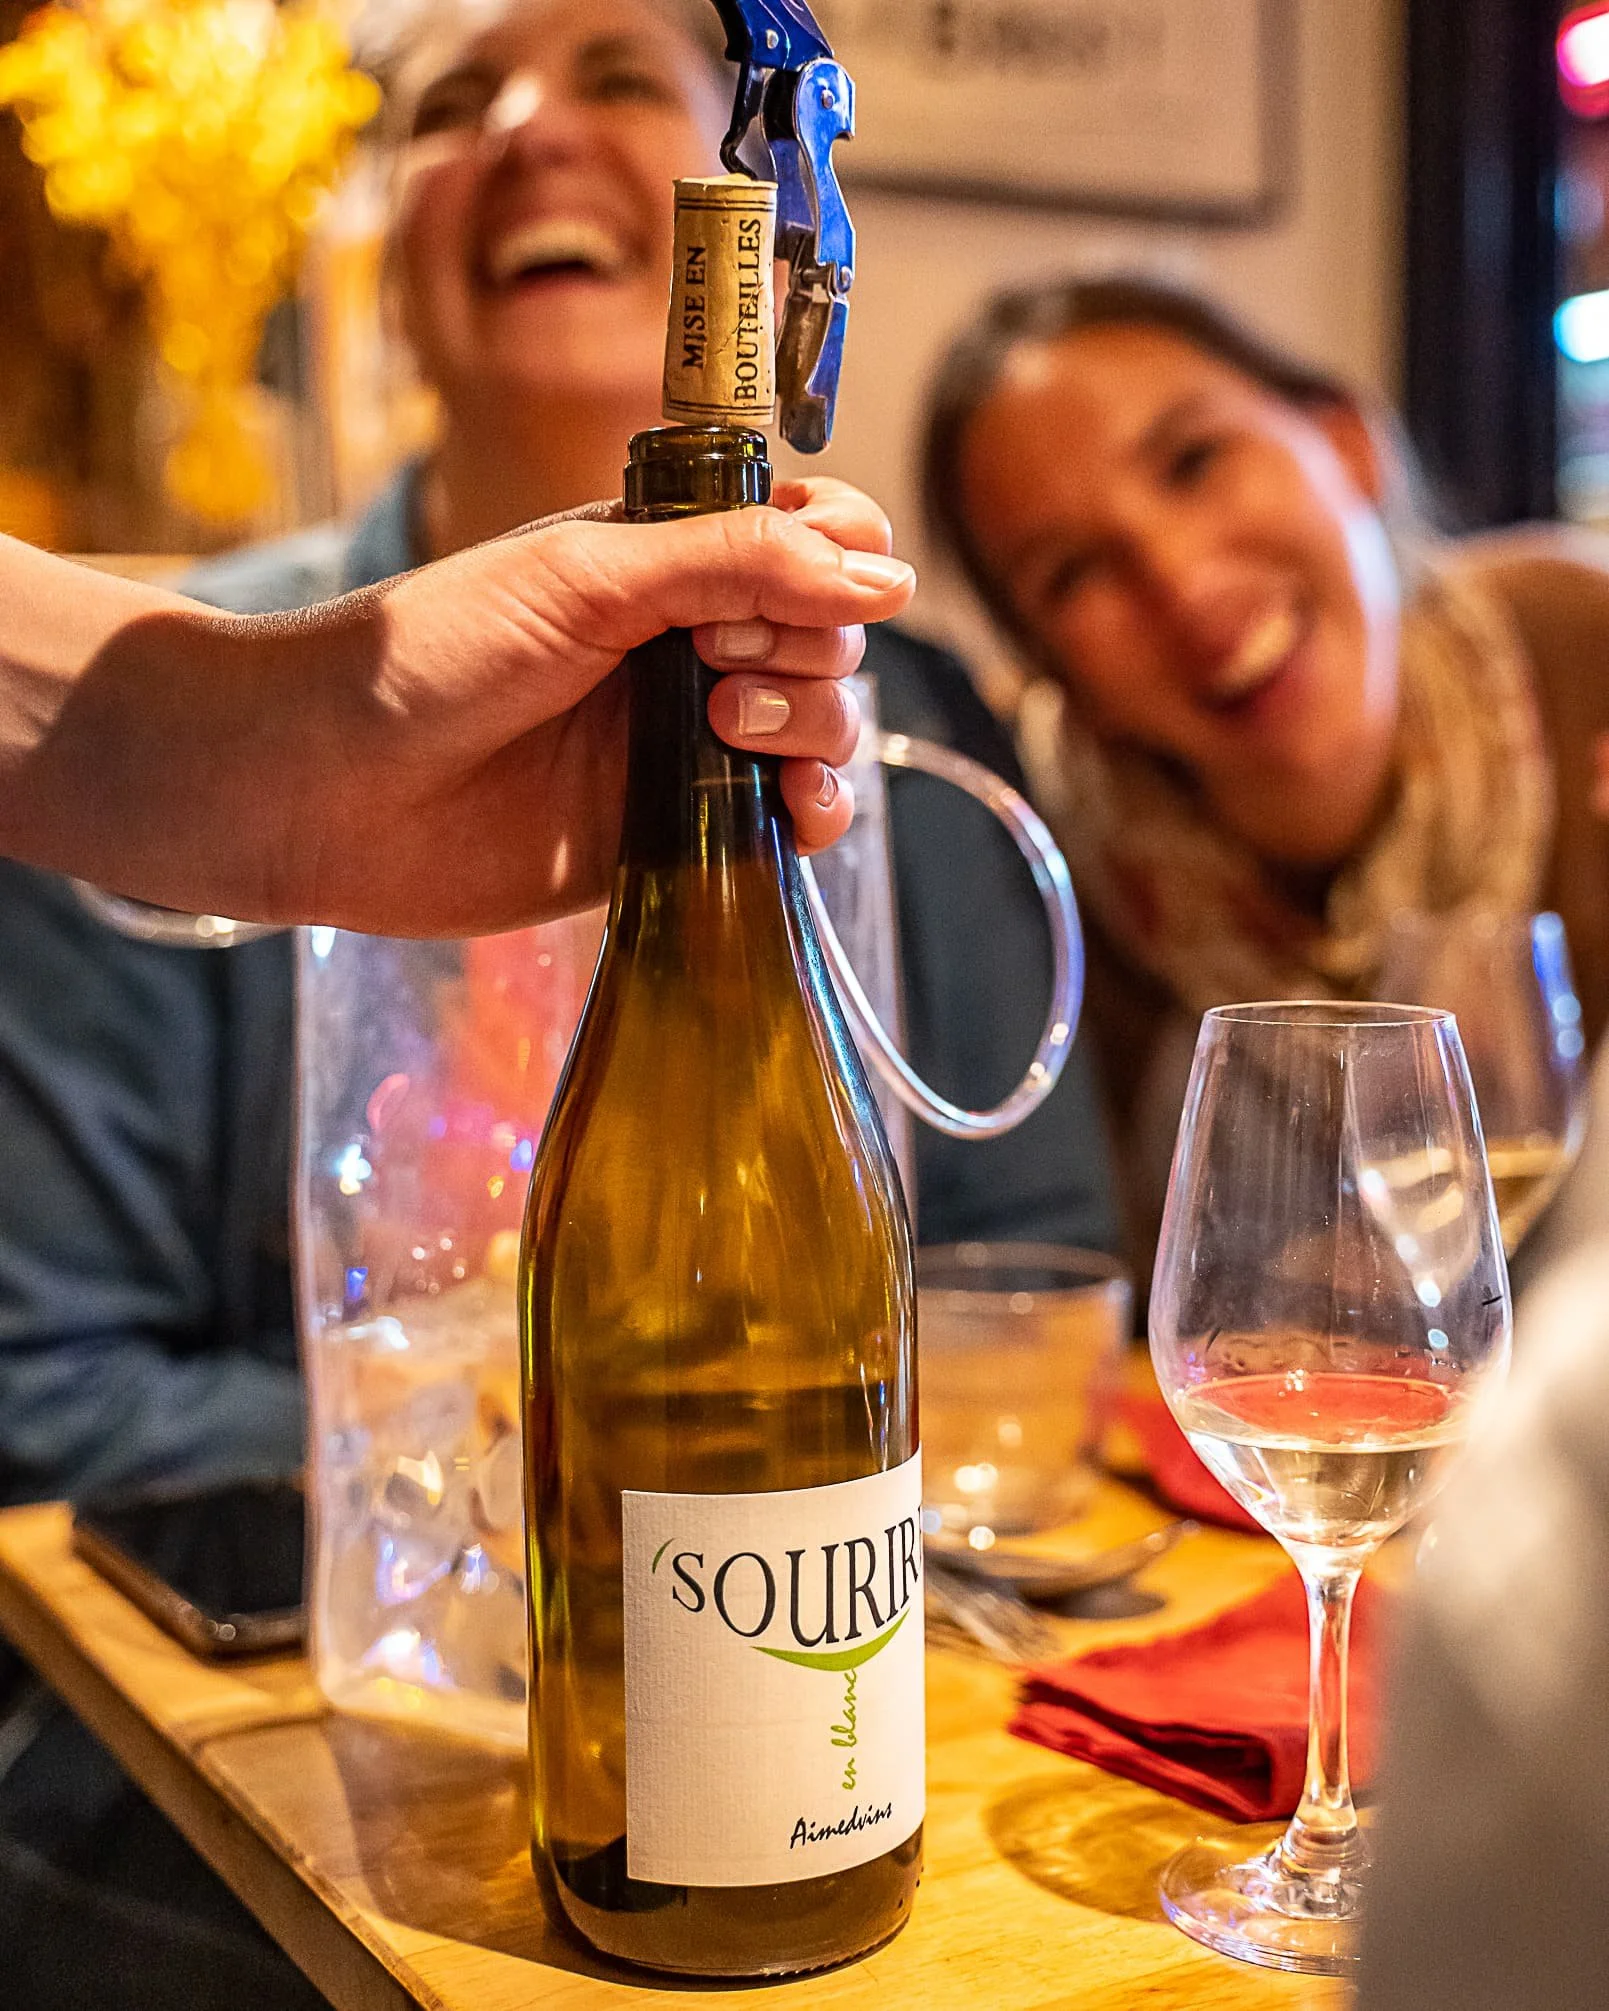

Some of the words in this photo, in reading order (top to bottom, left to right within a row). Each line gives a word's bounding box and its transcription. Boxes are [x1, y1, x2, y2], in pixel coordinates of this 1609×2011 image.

[686, 247, 706, 285] EN
[682, 295, 706, 369] MISE
[734, 218, 761, 402] BOUTEILLES
[671, 1505, 922, 1648] SOURIR
[830, 1667, 858, 1748] blanc
[841, 1757, 858, 1790] en
[789, 1802, 892, 1849] Aimedvins
